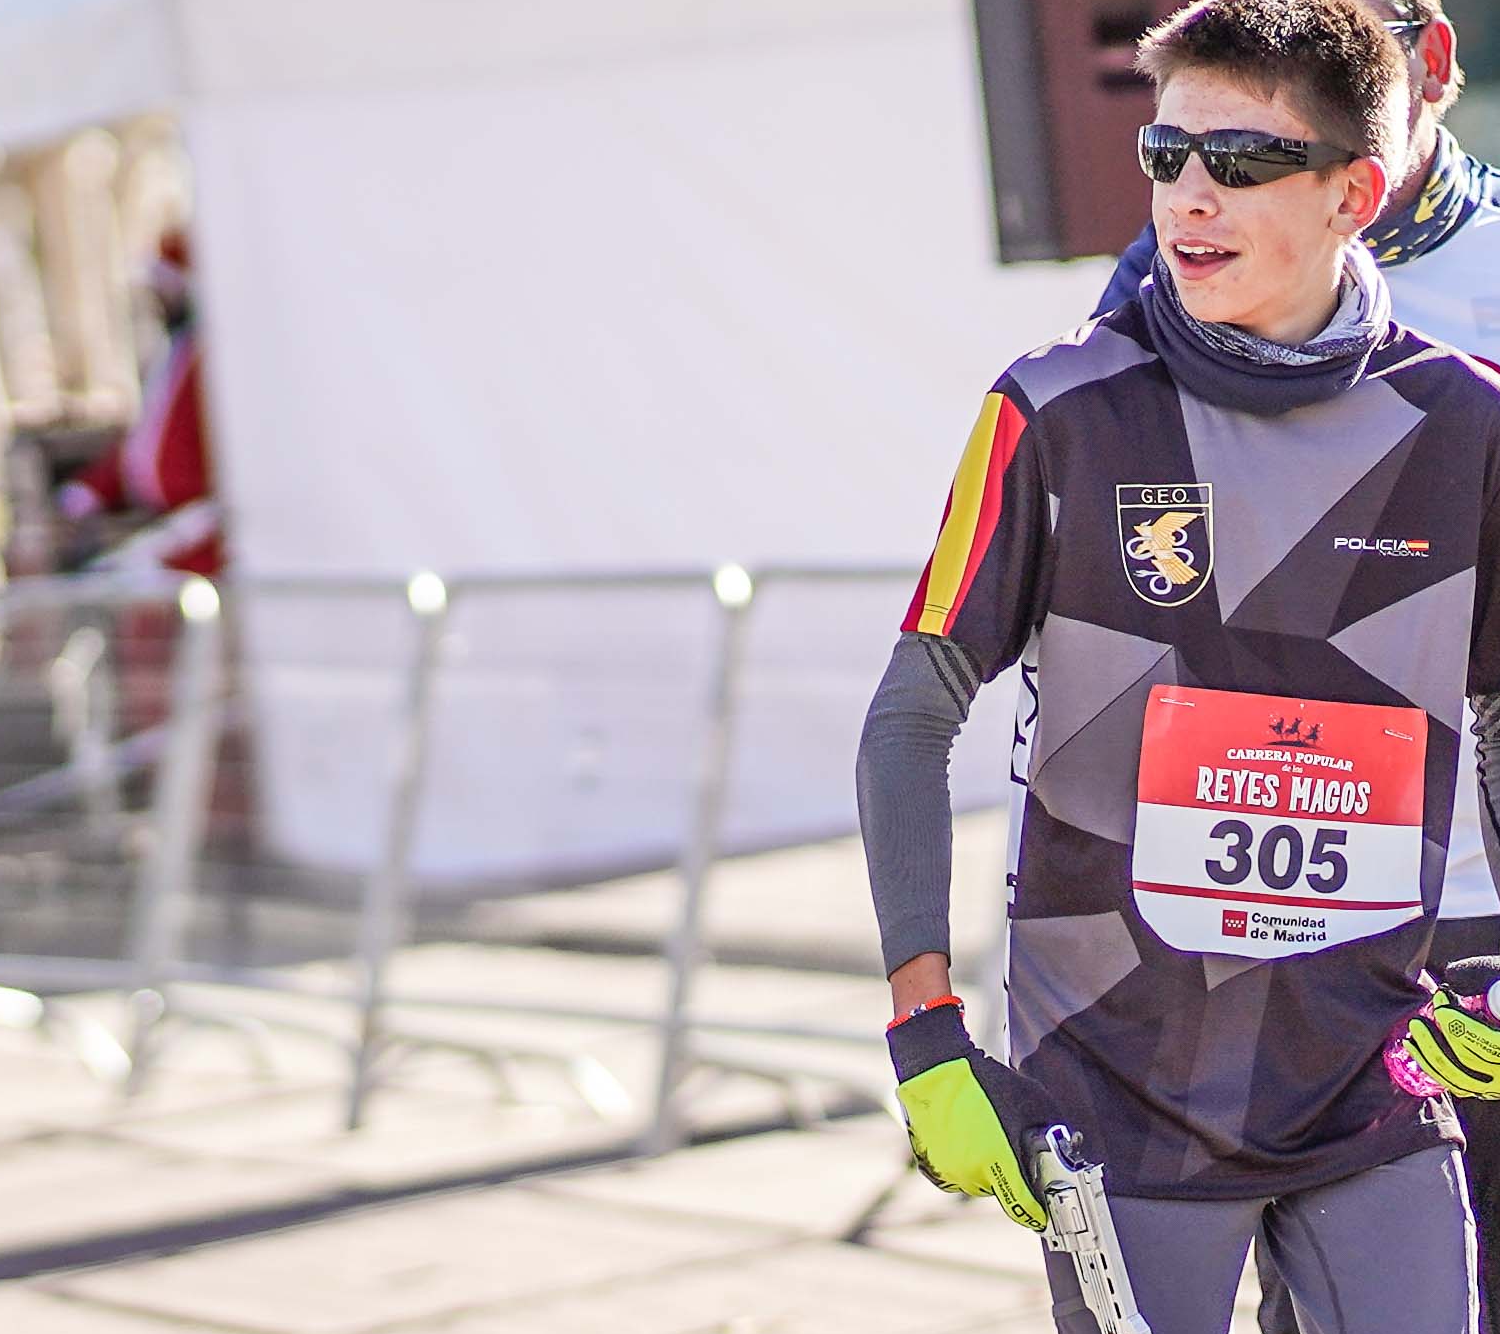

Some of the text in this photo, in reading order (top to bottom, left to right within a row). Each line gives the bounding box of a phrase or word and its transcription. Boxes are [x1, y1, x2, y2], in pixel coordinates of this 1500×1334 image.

[1141, 488, 1190, 504] G.E.O.
[1334, 537, 1408, 551] POLICIA
[1226, 748, 1354, 772] CARRERA POPULAR
[1281, 764, 1292, 773] de
[1196, 766, 1371, 815] REYES MAGOS
[1205, 819, 1348, 894] 305
[1251, 912, 1326, 928] Comunidad
[1250, 928, 1327, 943] de Madrid
